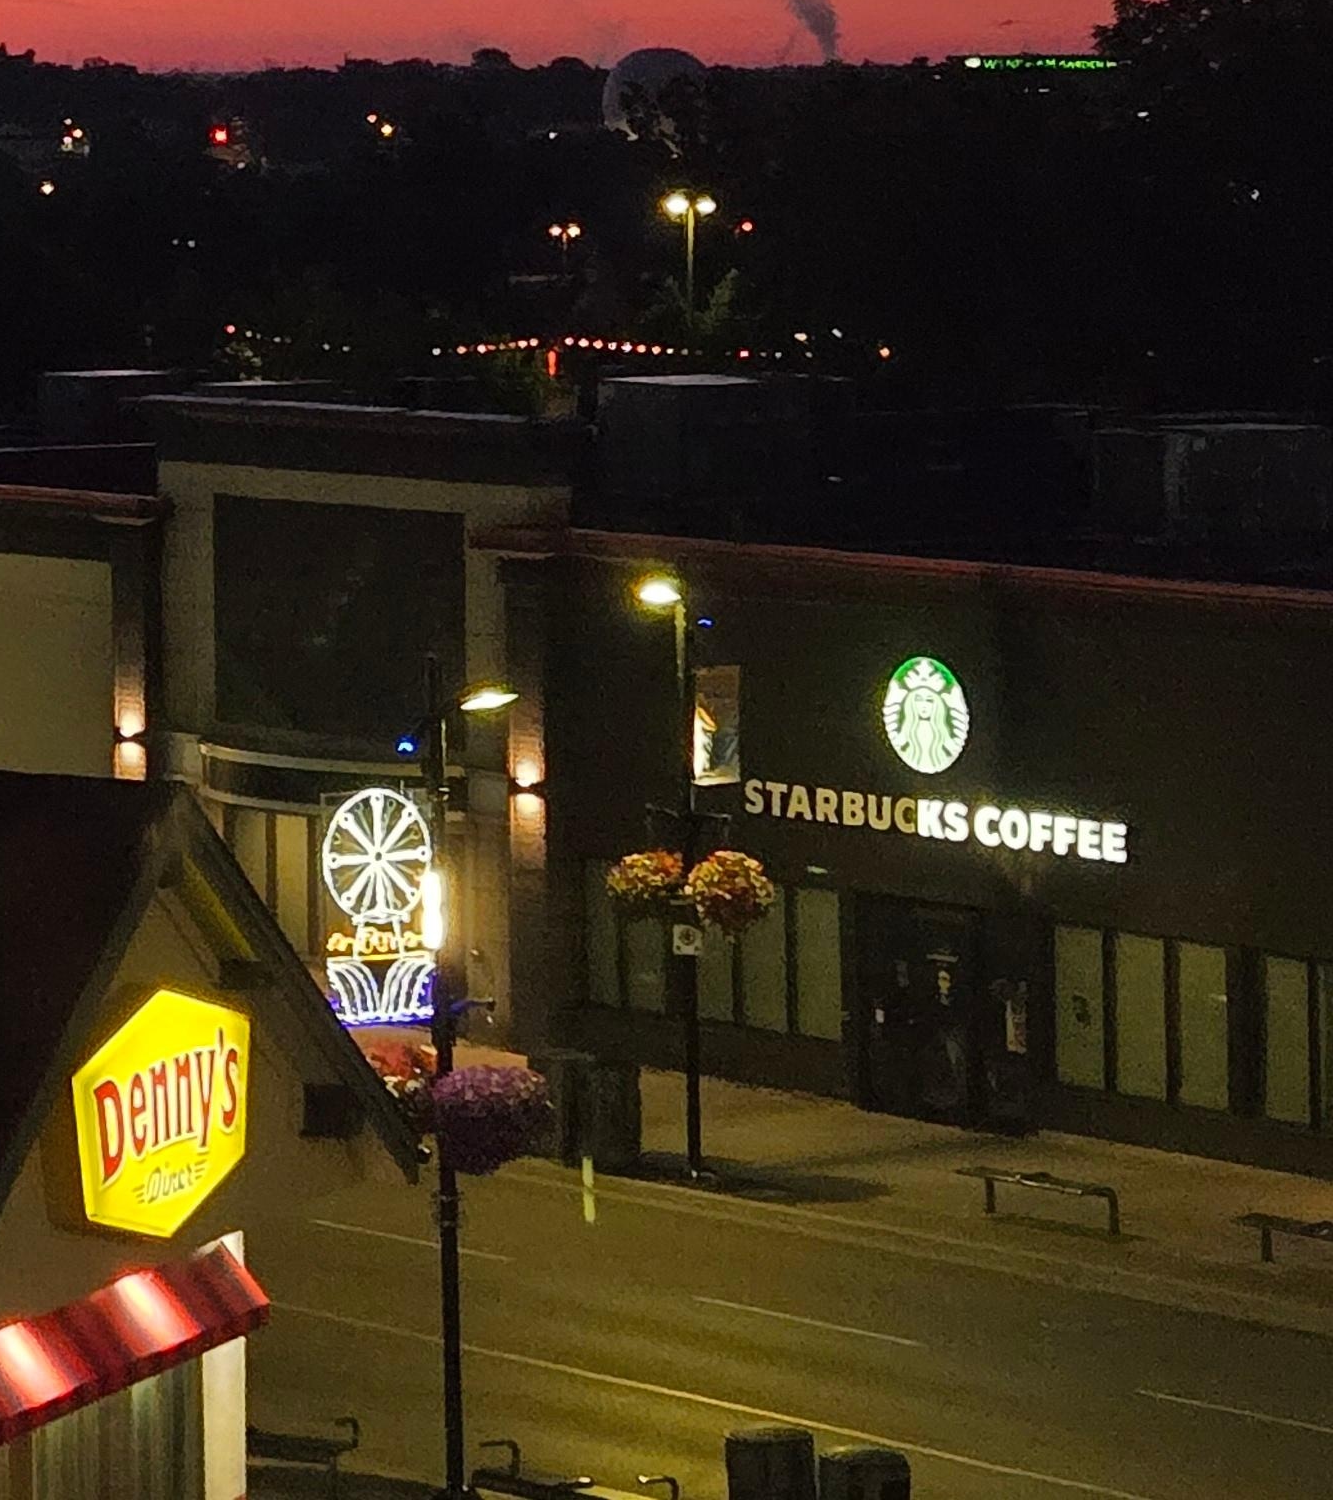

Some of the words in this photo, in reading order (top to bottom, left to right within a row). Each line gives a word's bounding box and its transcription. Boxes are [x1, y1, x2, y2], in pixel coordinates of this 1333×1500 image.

[744, 778, 969, 842] STARBUCKS
[974, 805, 1129, 864] COFFEE
[93, 1027, 238, 1185] Denny's
